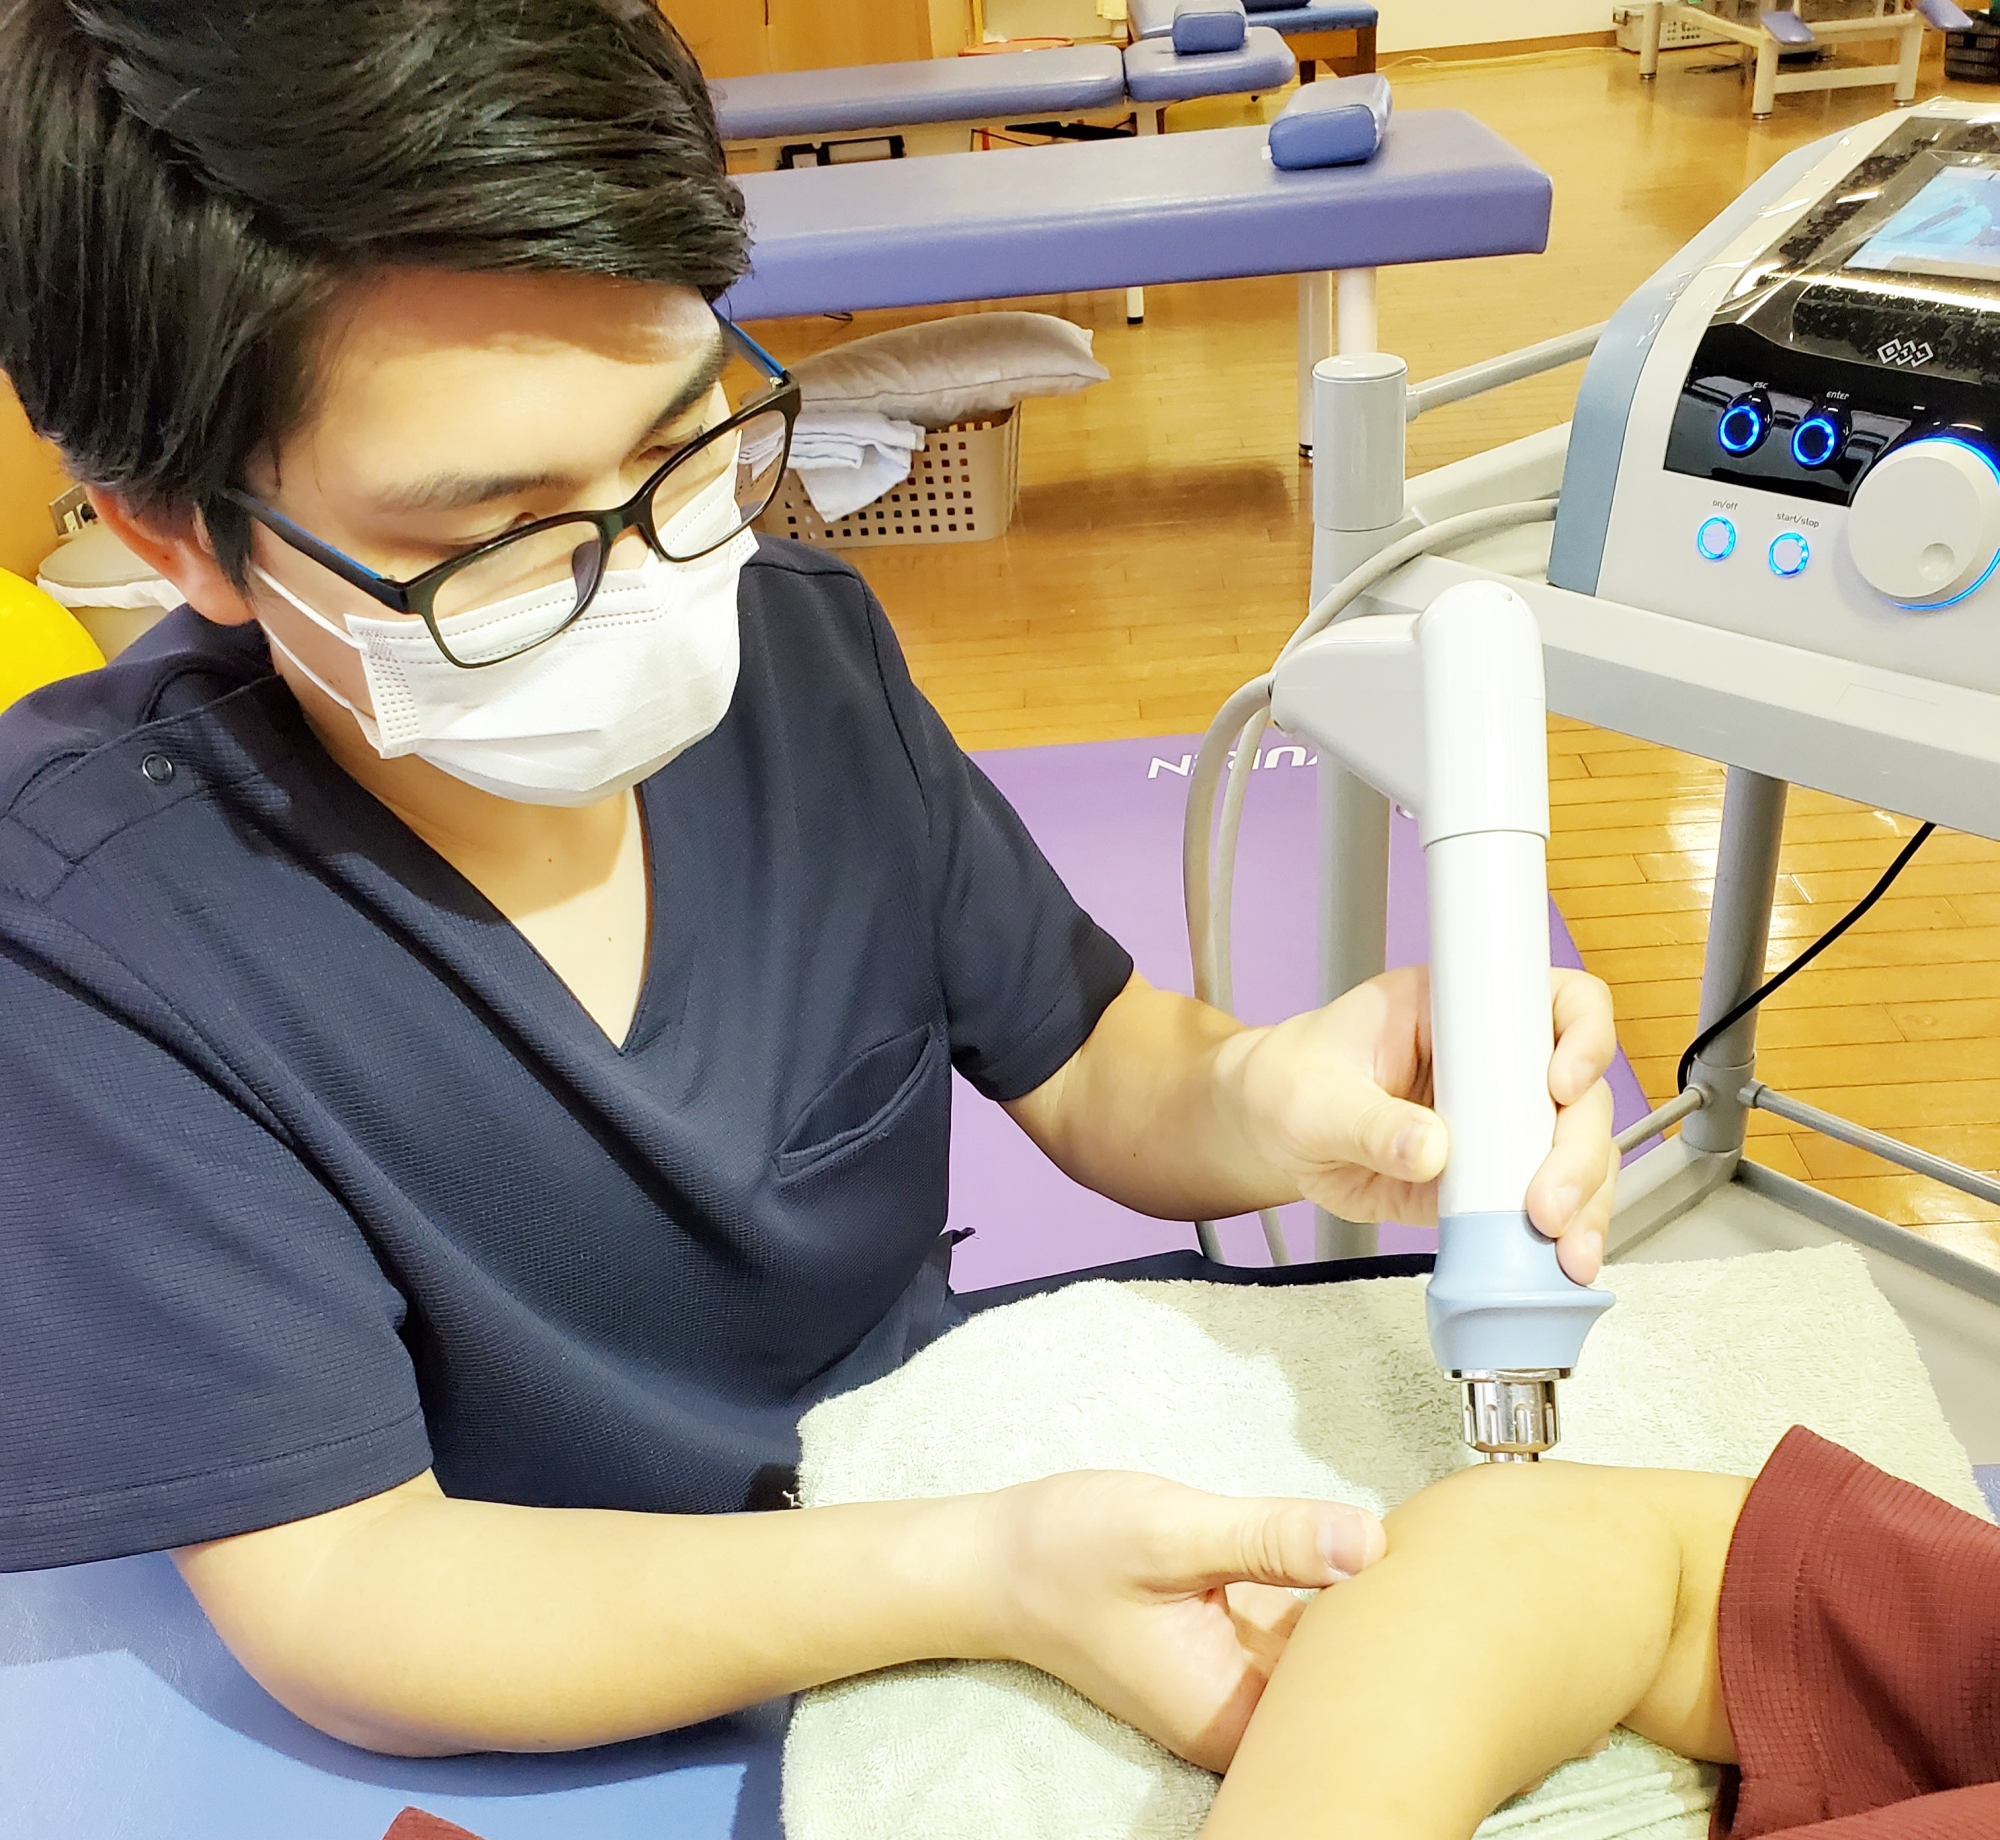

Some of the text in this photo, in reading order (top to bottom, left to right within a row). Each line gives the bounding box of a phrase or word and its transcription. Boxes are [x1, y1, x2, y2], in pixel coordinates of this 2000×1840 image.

[1753, 381, 1769, 390] esc
[1826, 390, 1850, 401] enter
[1712, 500, 1738, 511] on/off
[1776, 512, 1820, 529] start/stop
